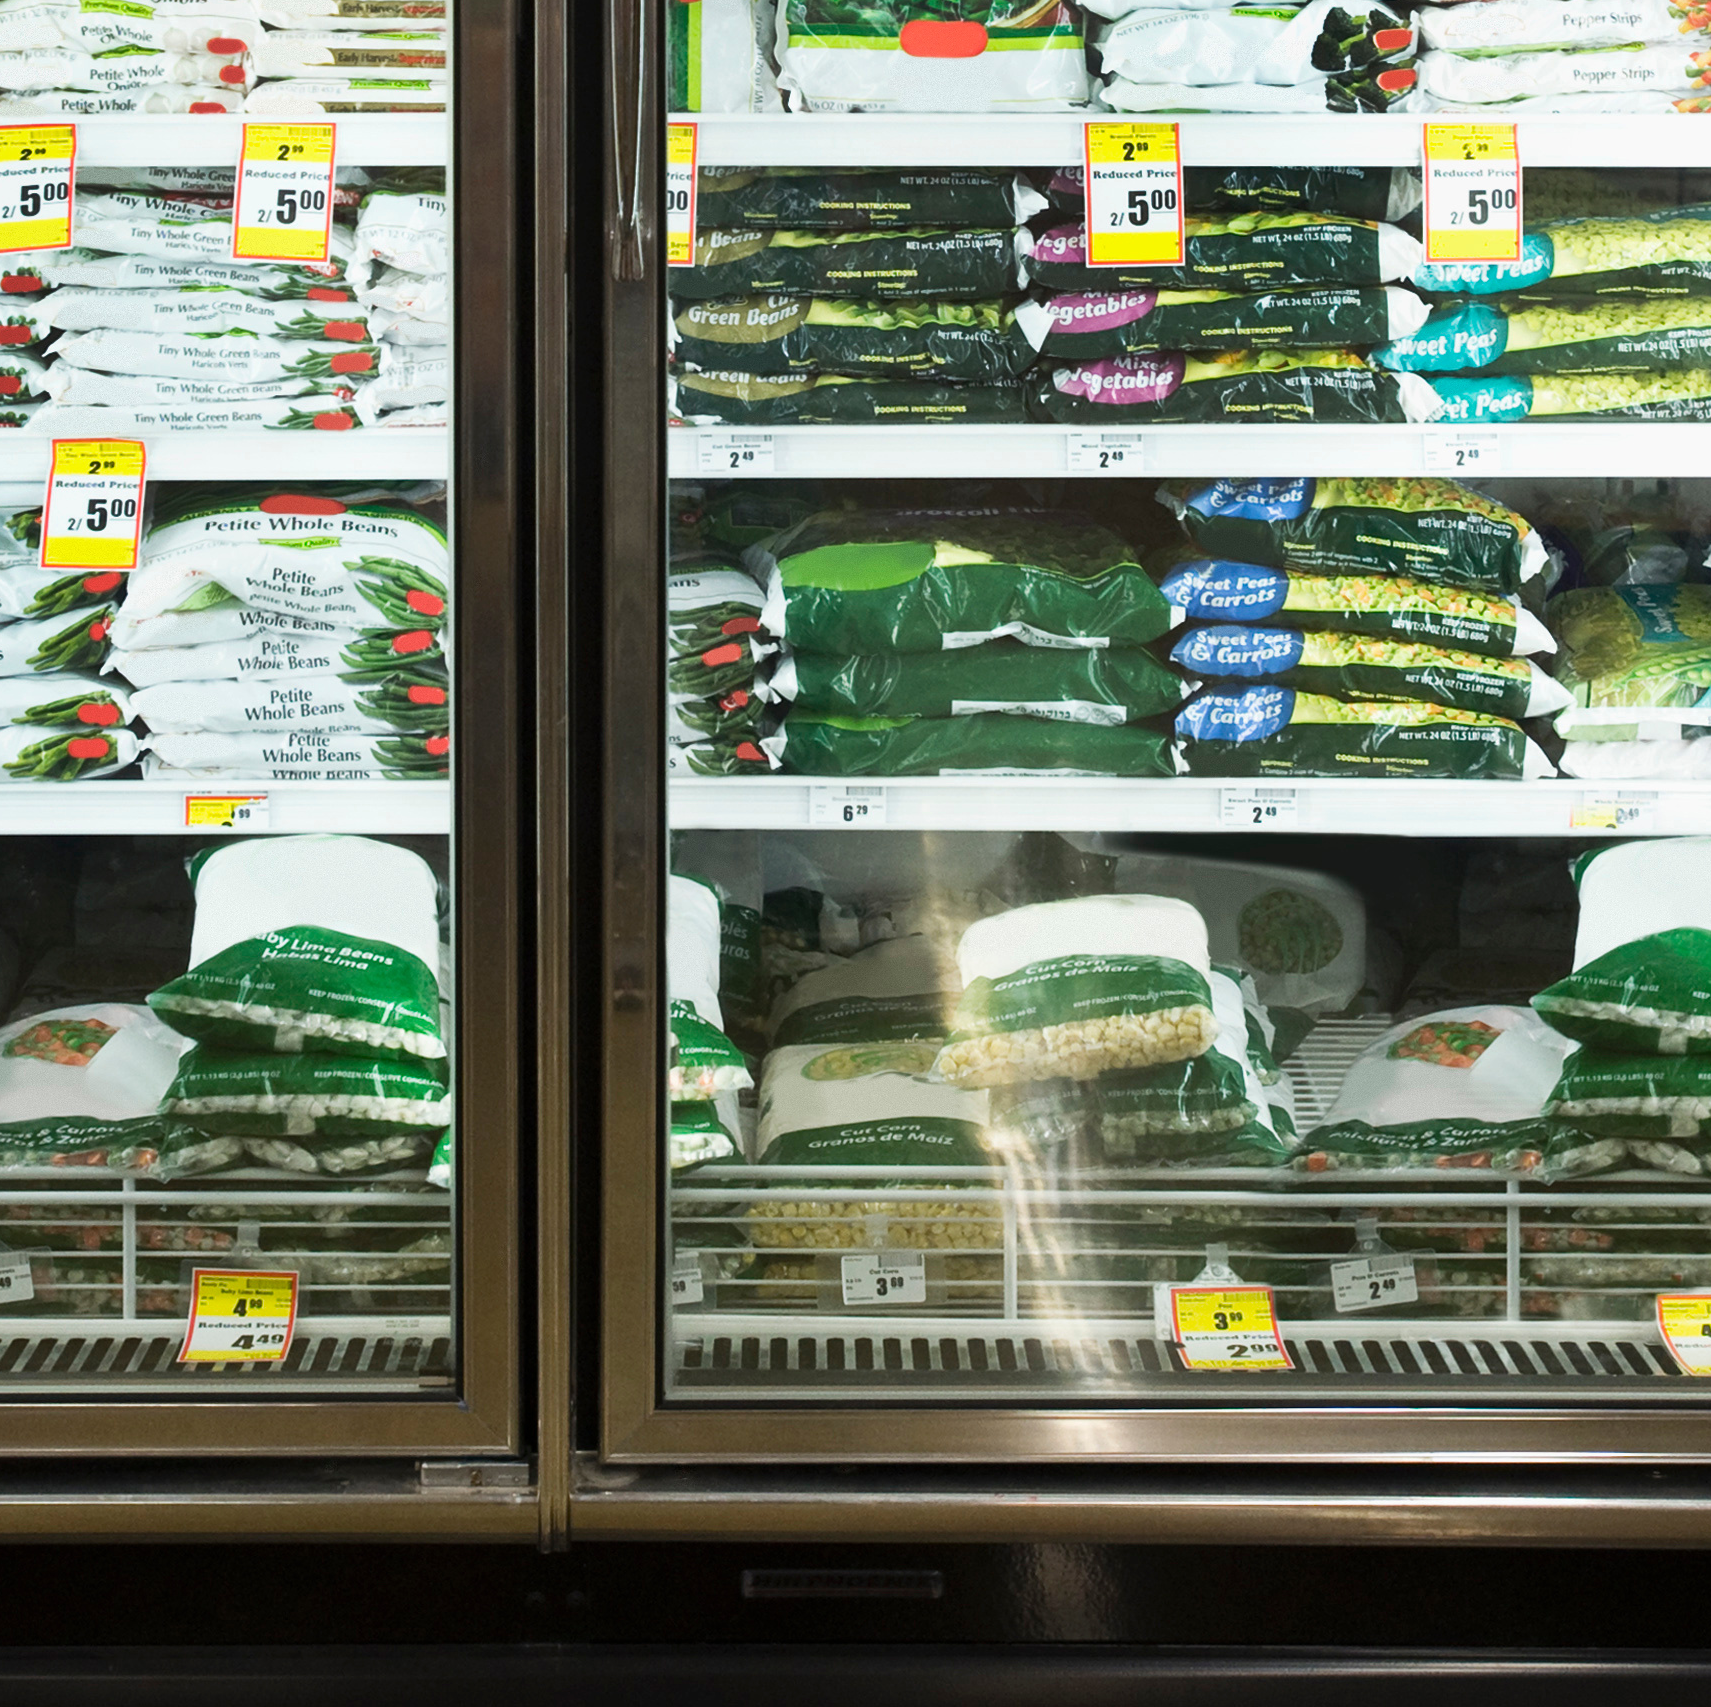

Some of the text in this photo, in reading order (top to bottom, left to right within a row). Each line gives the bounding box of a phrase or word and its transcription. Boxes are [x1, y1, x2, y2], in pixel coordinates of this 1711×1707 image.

[1562, 12, 1642, 27] Pepper Strips
[1093, 170, 1177, 179] Reduced Price
[690, 303, 799, 326] Green Beans
[1455, 330, 1497, 350] Peas
[134, 410, 262, 425] Tiny Whole Green Beans
[55, 480, 140, 490] Reduced Price
[205, 517, 262, 532] Petite
[269, 517, 333, 532] Whole
[341, 519, 398, 538] Beans
[1200, 590, 1276, 606] Carrots
[1196, 631, 1292, 644] Sweet Peas
[270, 689, 312, 704] Petite
[245, 702, 345, 721] Whole Beans
[262, 749, 361, 763] Whole Beans
[292, 936, 393, 966] Lima Beans
[1065, 959, 1107, 970] Corn
[993, 975, 1062, 992] Granos
